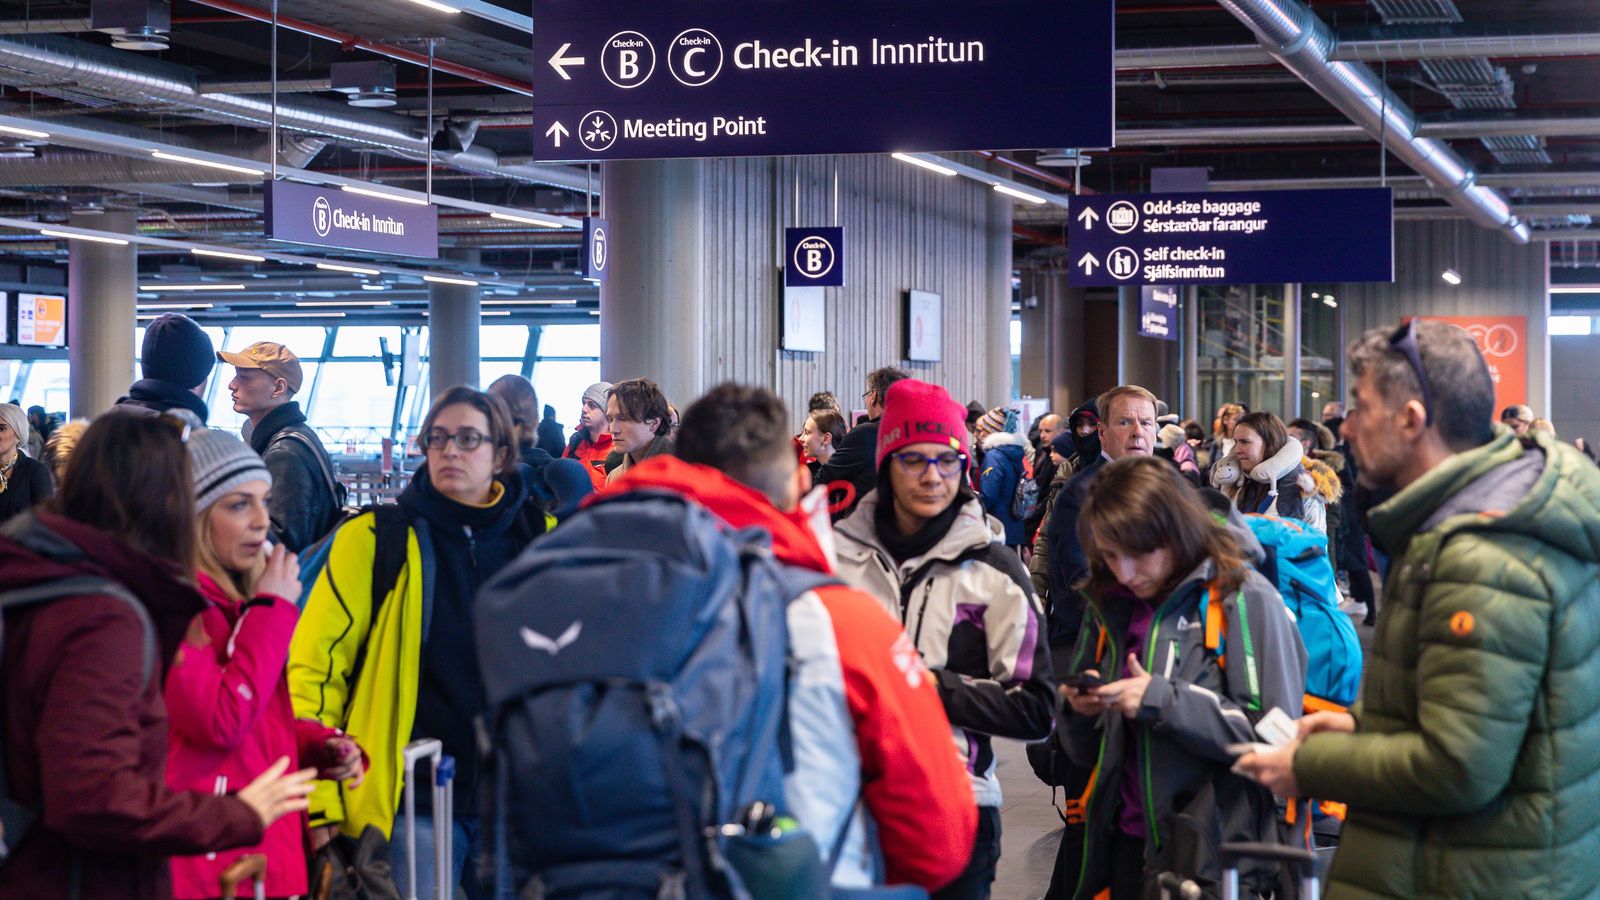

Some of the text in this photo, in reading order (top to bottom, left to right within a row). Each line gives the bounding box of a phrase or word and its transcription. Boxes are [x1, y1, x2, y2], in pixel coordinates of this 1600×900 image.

[612, 39, 644, 48] Check-in
[679, 36, 711, 46] Check-in
[684, 47, 706, 77] C
[733, 35, 984, 70] Check-in Innritun
[620, 49, 639, 80] B
[623, 116, 766, 142] Meeting Point
[1143, 199, 1261, 216] Odd-size baggage
[319, 210, 326, 230] B
[333, 207, 405, 236] Check-in Innritun
[1143, 215, 1268, 234] Sérstærðar farangur
[596, 241, 603, 264] B
[802, 242, 826, 250] Check-in
[1143, 246, 1225, 261] Self check-in
[807, 250, 822, 272] B
[1143, 264, 1225, 282] Sjálfsinnritun
